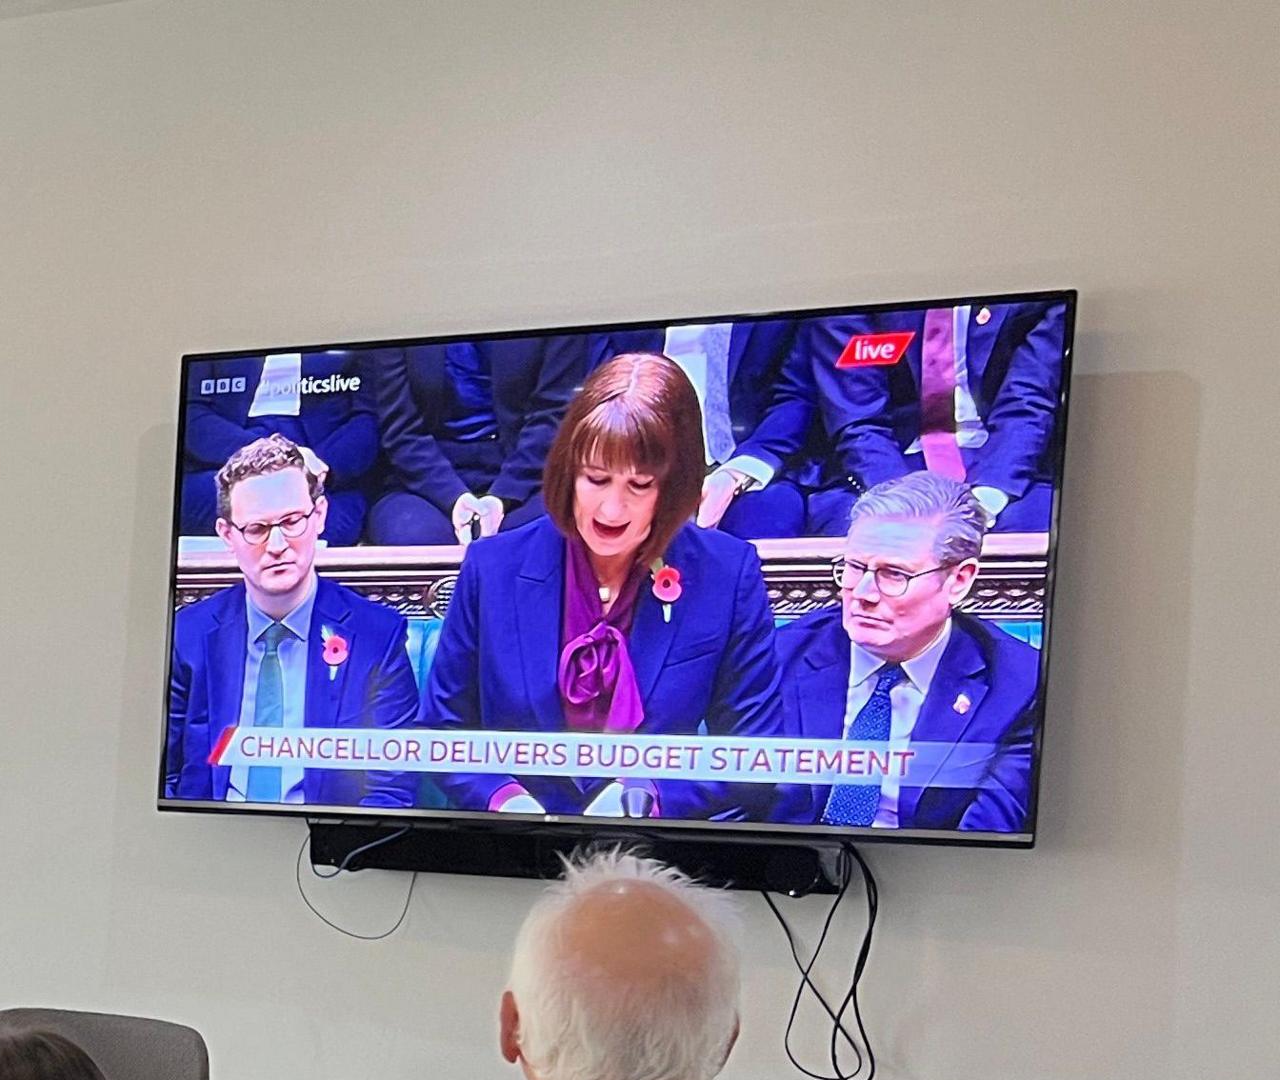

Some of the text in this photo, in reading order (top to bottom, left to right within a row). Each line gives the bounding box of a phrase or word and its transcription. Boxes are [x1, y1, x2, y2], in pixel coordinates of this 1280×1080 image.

[854, 340, 896, 361] live
[240, 735, 915, 776] CHANCELLOR DELIVERS BUDGET STATEMENT
